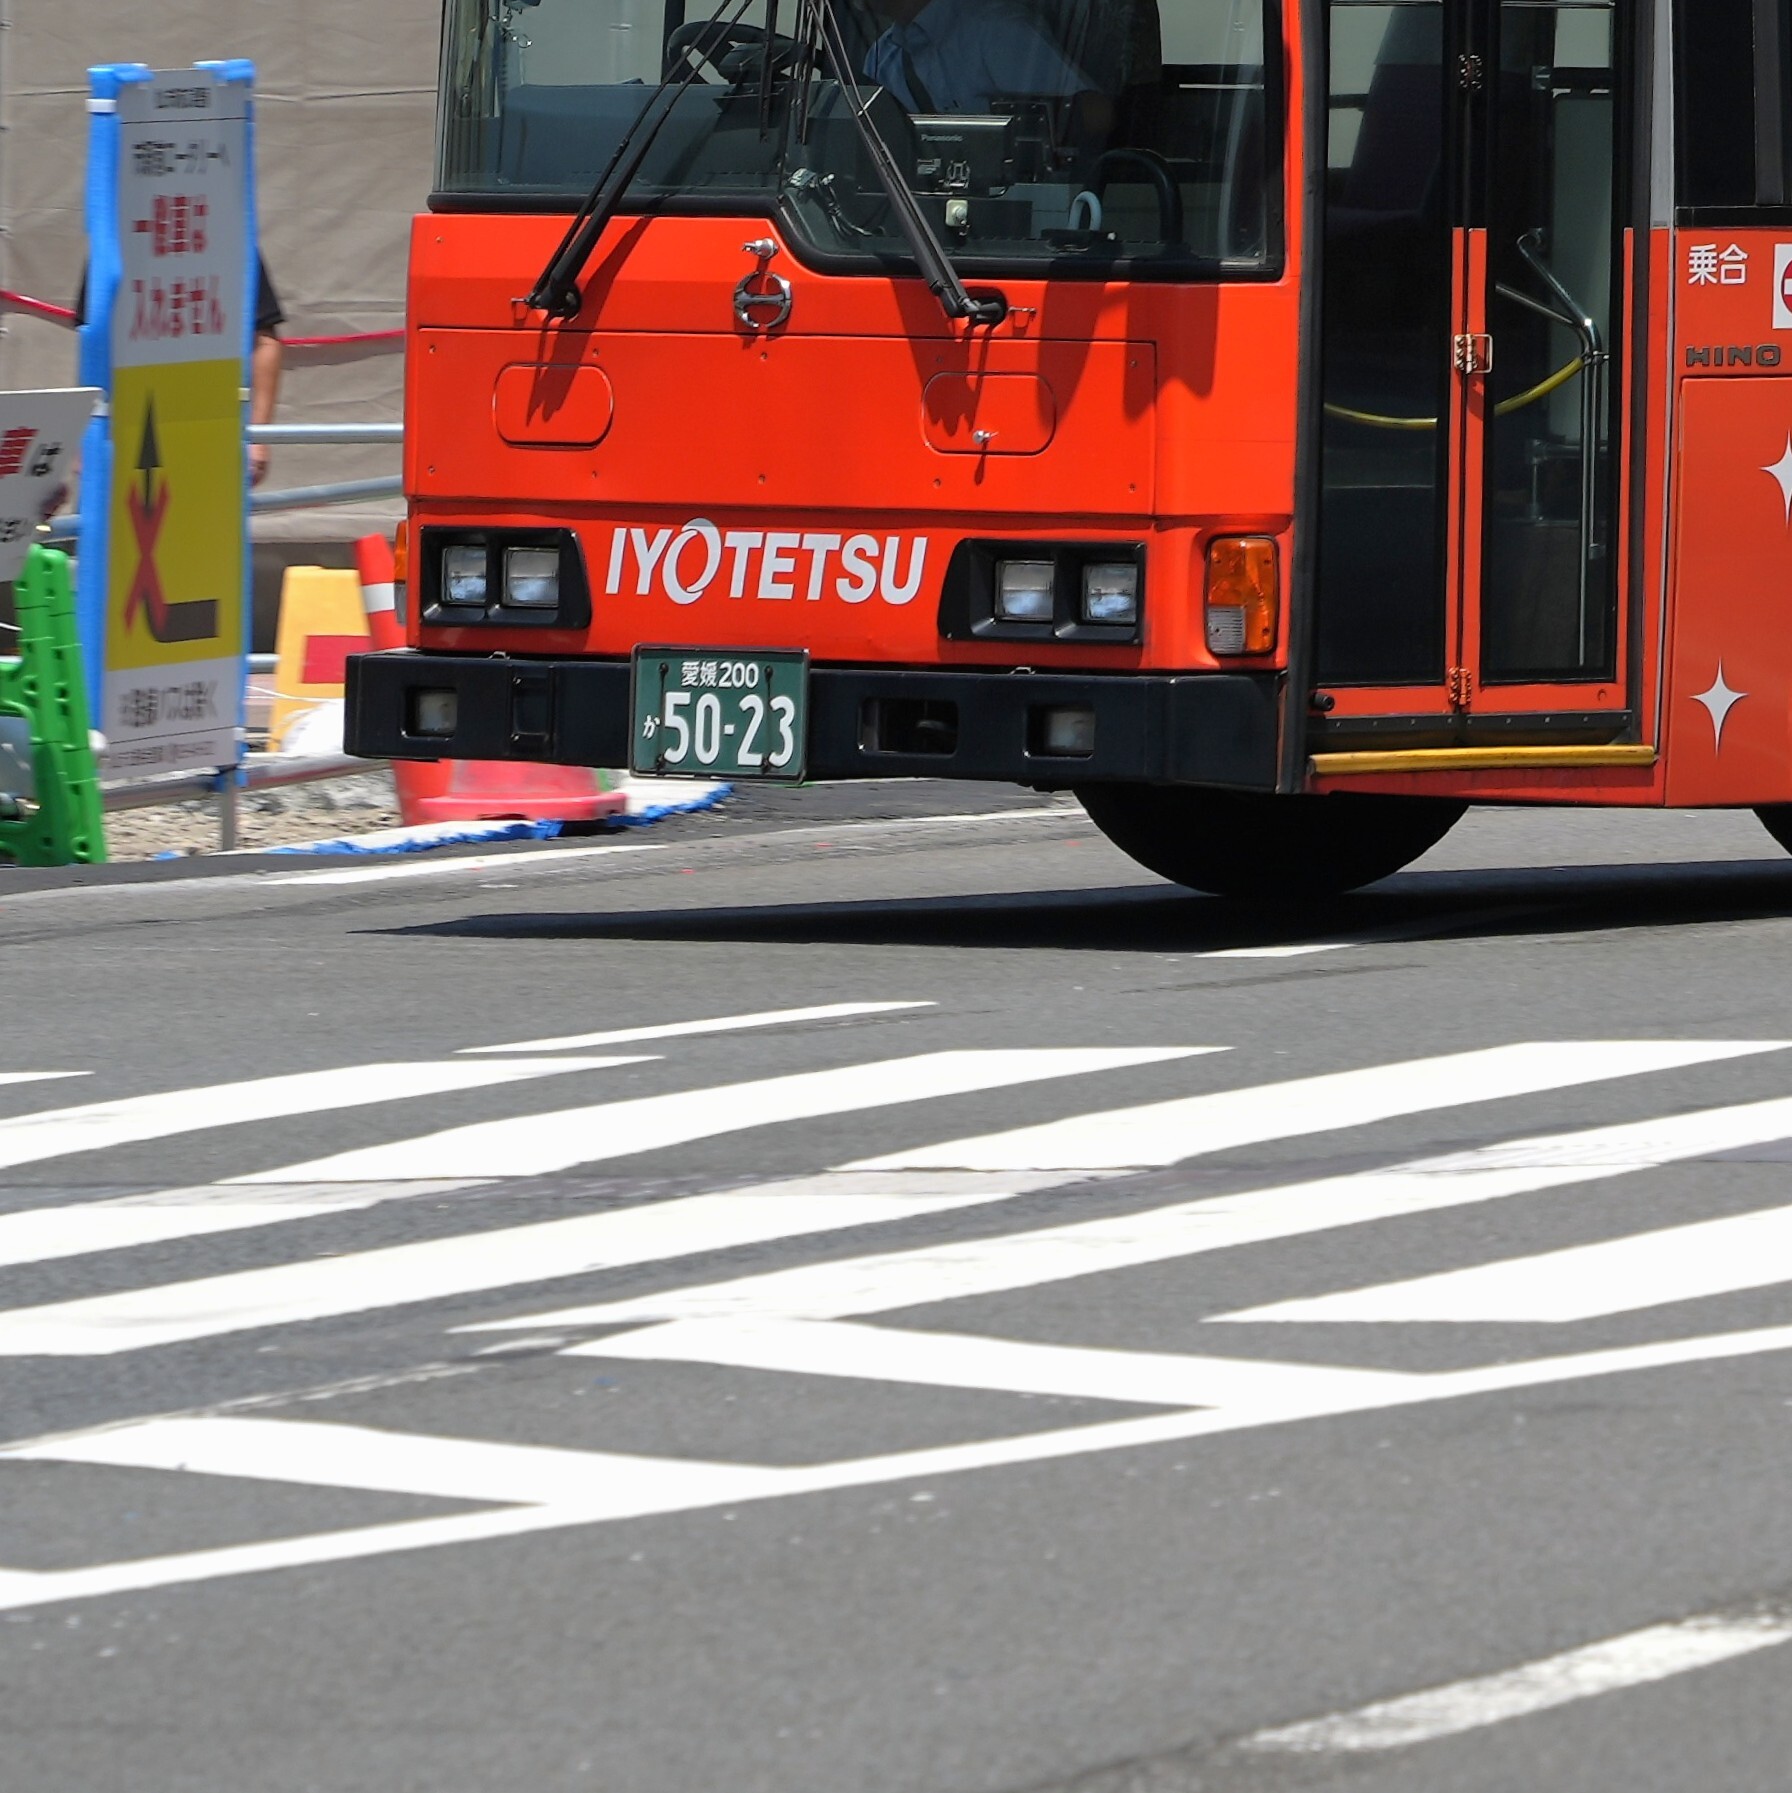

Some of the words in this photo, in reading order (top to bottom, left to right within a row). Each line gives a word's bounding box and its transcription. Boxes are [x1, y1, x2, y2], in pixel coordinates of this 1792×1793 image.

[1688, 243, 1748, 285] 乗合
[129, 275, 225, 340] 入れません
[1686, 344, 1781, 366] HINO
[605, 518, 927, 605] IYOTETSU
[681, 661, 759, 688] 愛媛200
[642, 714, 661, 739] か
